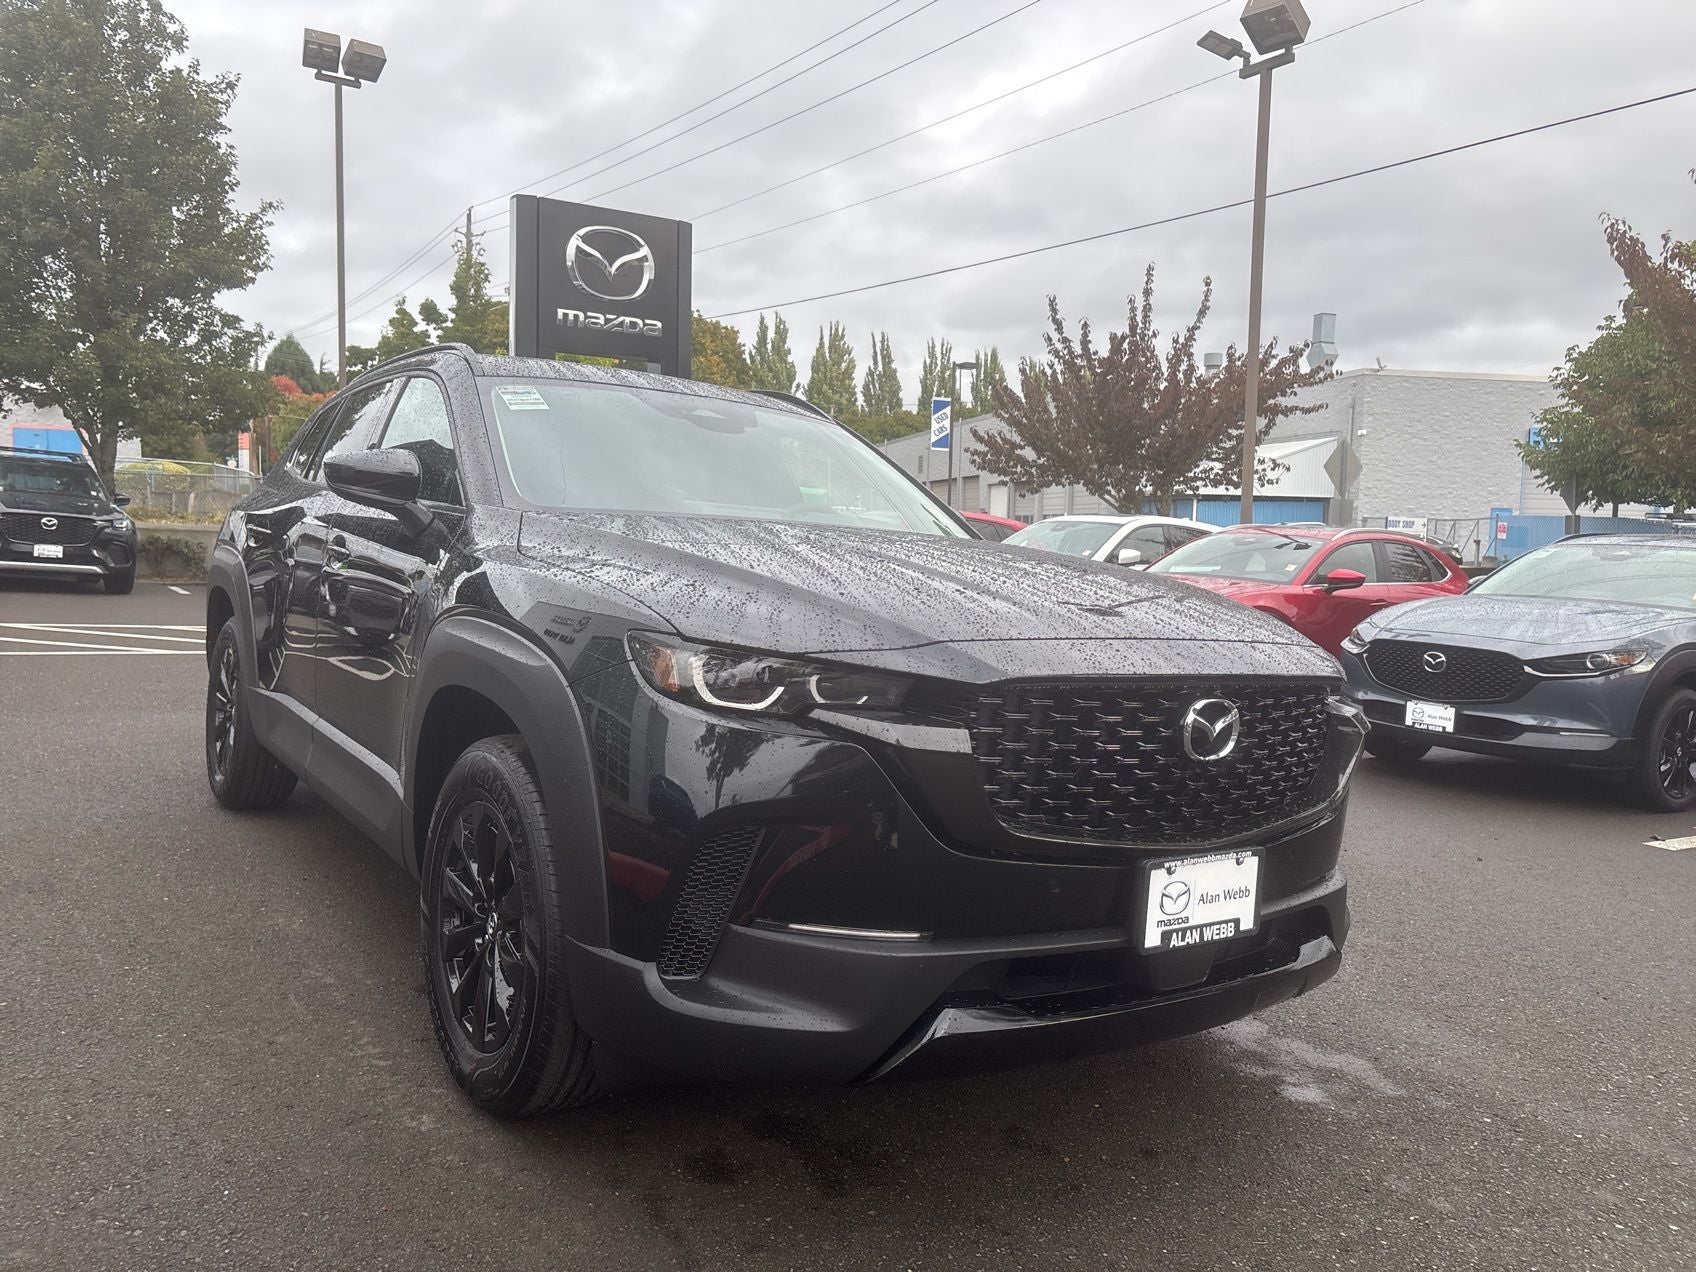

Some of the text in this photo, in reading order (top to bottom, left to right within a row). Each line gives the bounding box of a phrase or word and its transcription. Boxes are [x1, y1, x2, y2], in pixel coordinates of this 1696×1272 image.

[556, 308, 662, 337] mazda
[933, 412, 949, 425] USED
[933, 424, 948, 437] CARS
[1387, 519, 1415, 529] BODY SHOP
[1414, 722, 1443, 732] ALAN WEBB
[1164, 851, 1252, 869] www.alanwebbmazda.com
[1198, 886, 1251, 905] Alan Webb
[1156, 916, 1190, 928] mazda
[1169, 922, 1235, 948] ALAN WEBB
